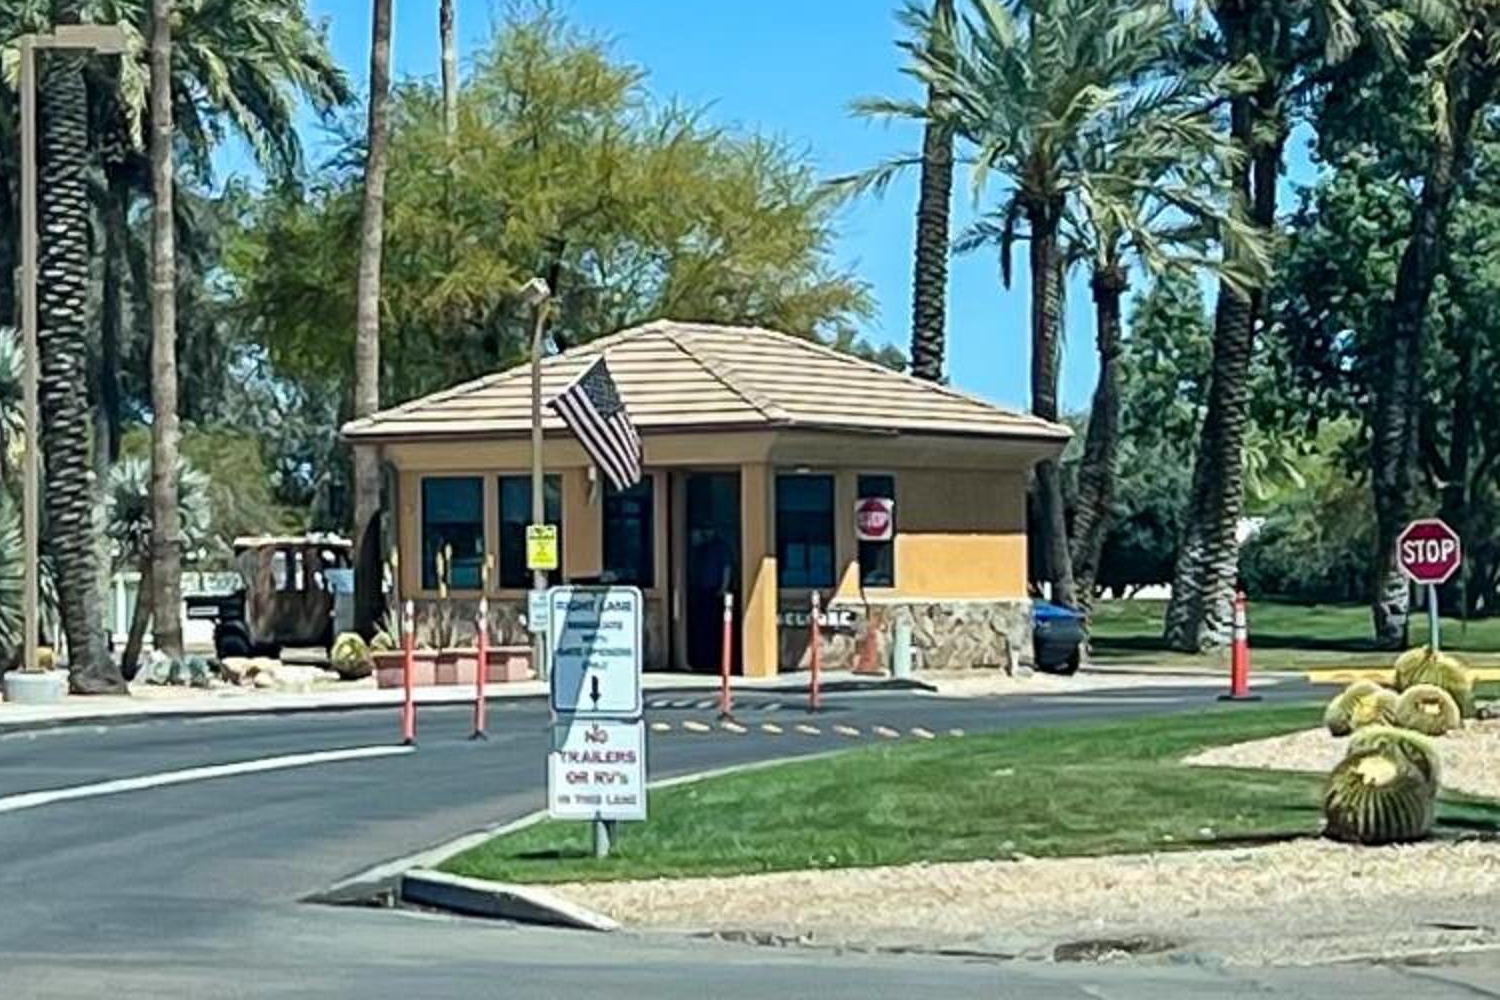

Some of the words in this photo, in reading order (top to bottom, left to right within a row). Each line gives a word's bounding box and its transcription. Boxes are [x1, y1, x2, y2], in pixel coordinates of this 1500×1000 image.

[1403, 539, 1454, 563] STOP
[585, 729, 608, 743] NO
[561, 750, 637, 763] TRAILERS
[566, 771, 589, 784] OR
[606, 794, 637, 805] LANE
